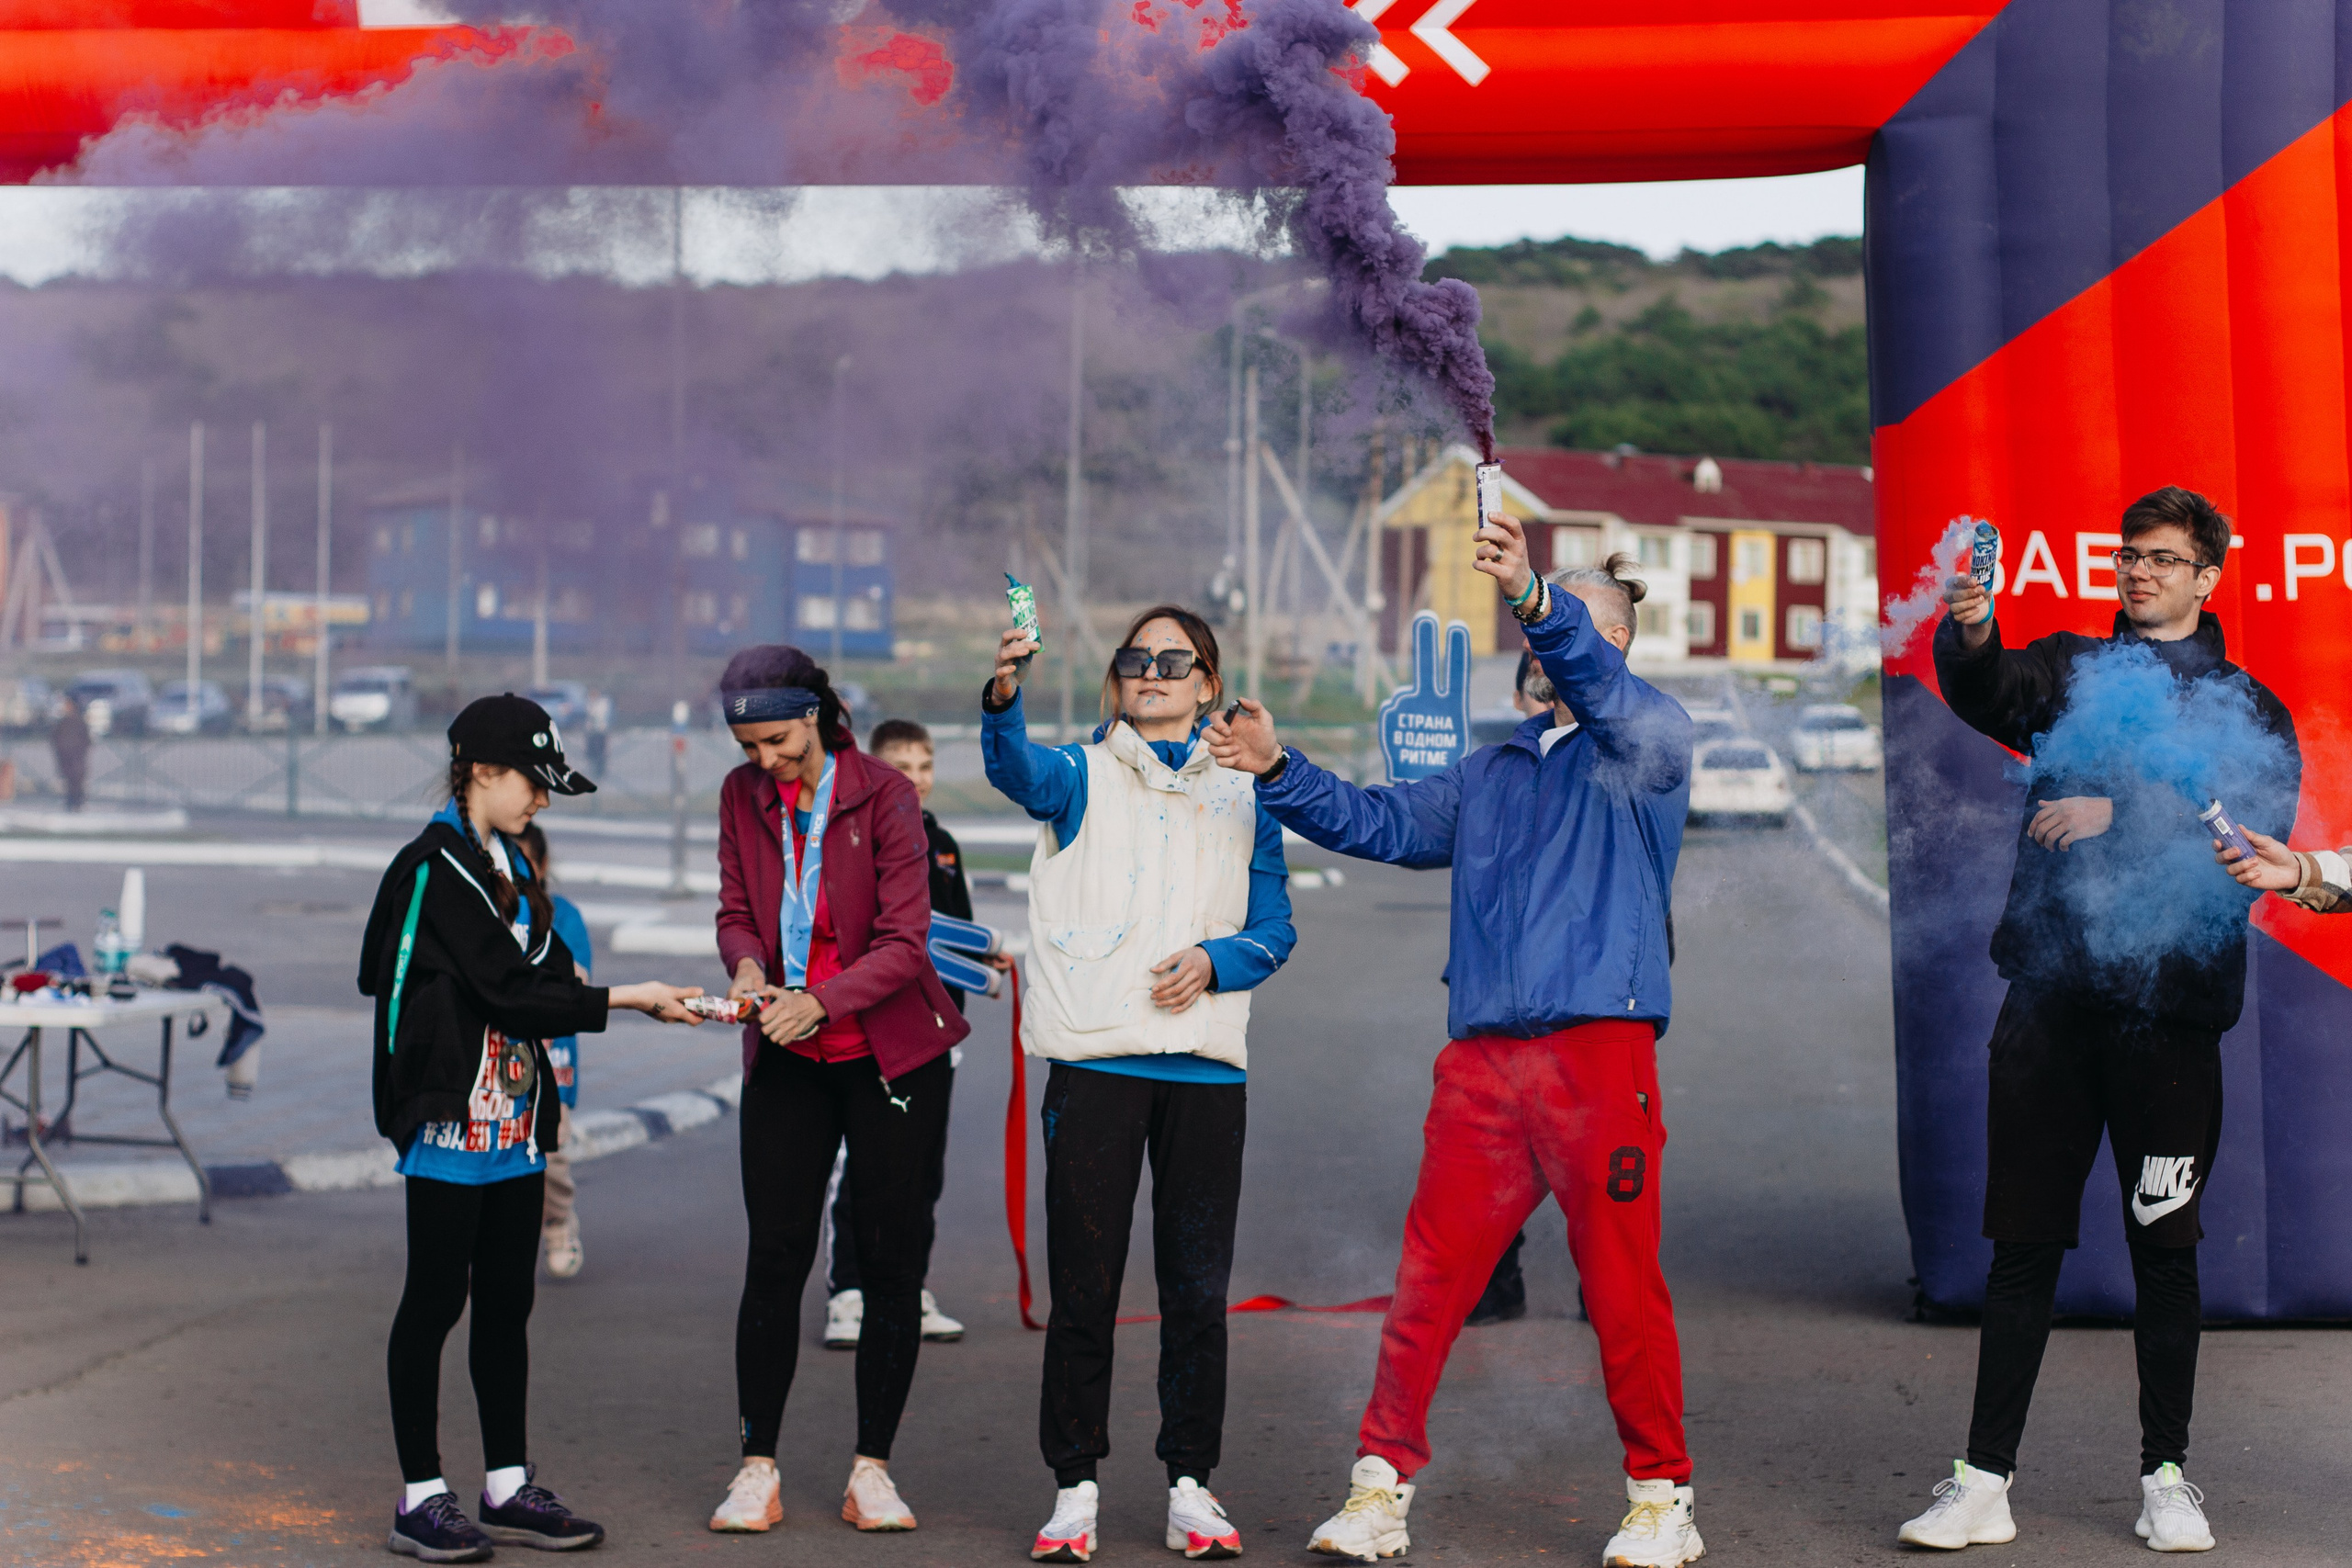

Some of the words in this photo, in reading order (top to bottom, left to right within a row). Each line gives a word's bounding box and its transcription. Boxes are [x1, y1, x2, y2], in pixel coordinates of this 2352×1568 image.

[1397, 713, 1453, 730] СТРАНА
[1393, 730, 1403, 746] В
[1405, 731, 1457, 749] ОДНОМ
[1399, 749, 1448, 766] РИТМЕ
[1606, 1145, 1646, 1203] 8
[2138, 1155, 2195, 1198] NIKE
